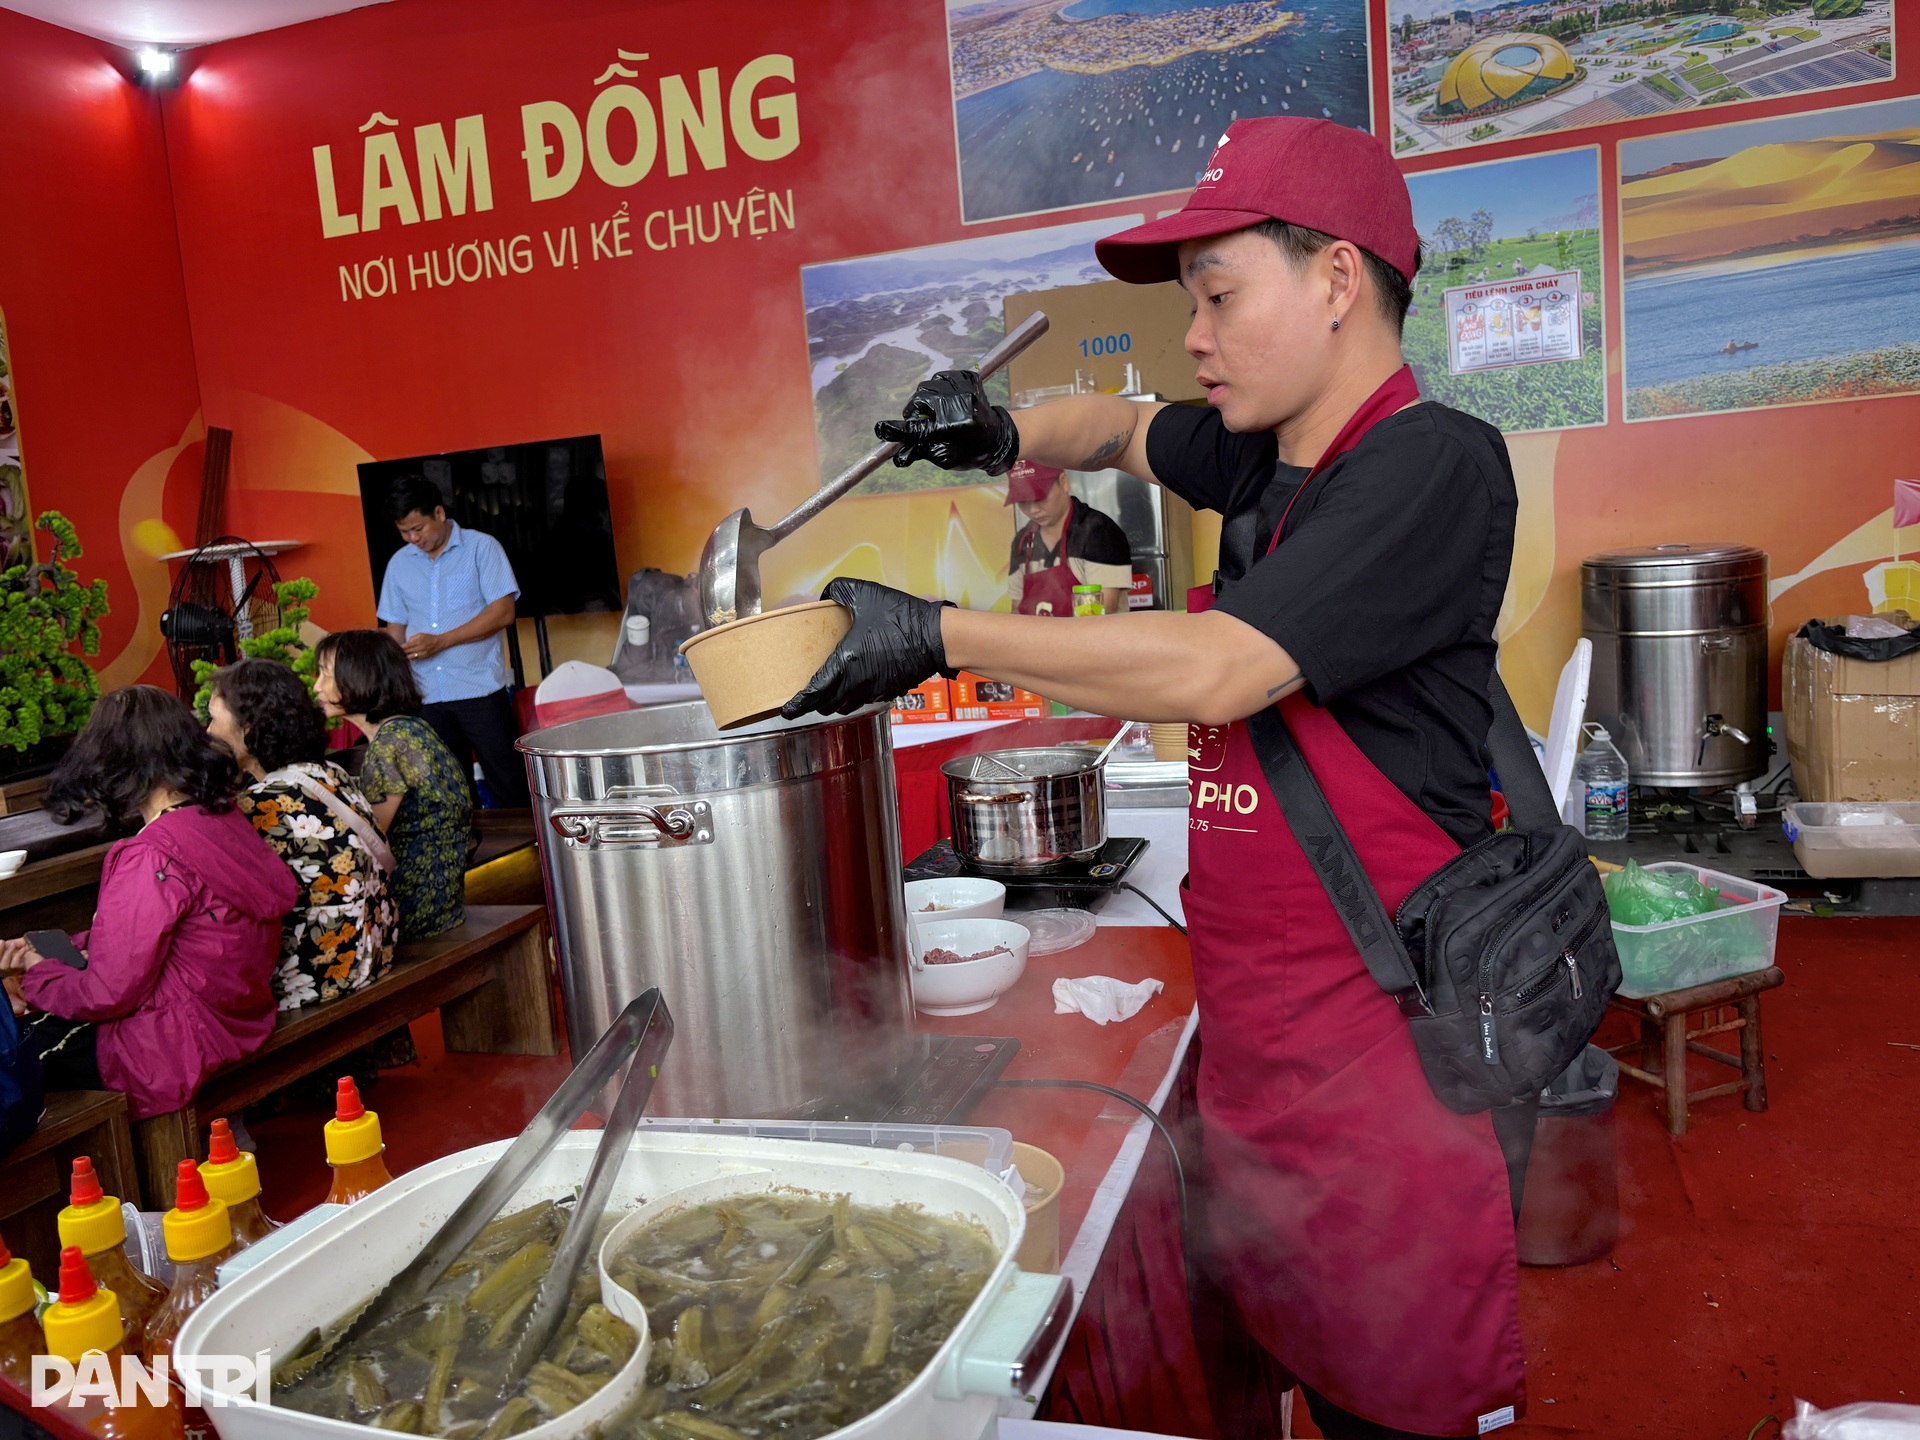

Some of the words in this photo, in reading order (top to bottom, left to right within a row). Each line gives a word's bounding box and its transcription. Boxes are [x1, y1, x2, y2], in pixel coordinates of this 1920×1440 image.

[312, 111, 493, 239] LÂM
[521, 48, 800, 202] ĐỒNG
[338, 256, 397, 302] NƠI
[408, 234, 533, 291] HƯƠNG
[543, 226, 580, 270] VỊ
[590, 201, 633, 261] KỂ
[644, 186, 796, 250] CHUYỆN
[1079, 333, 1131, 358] 1000
